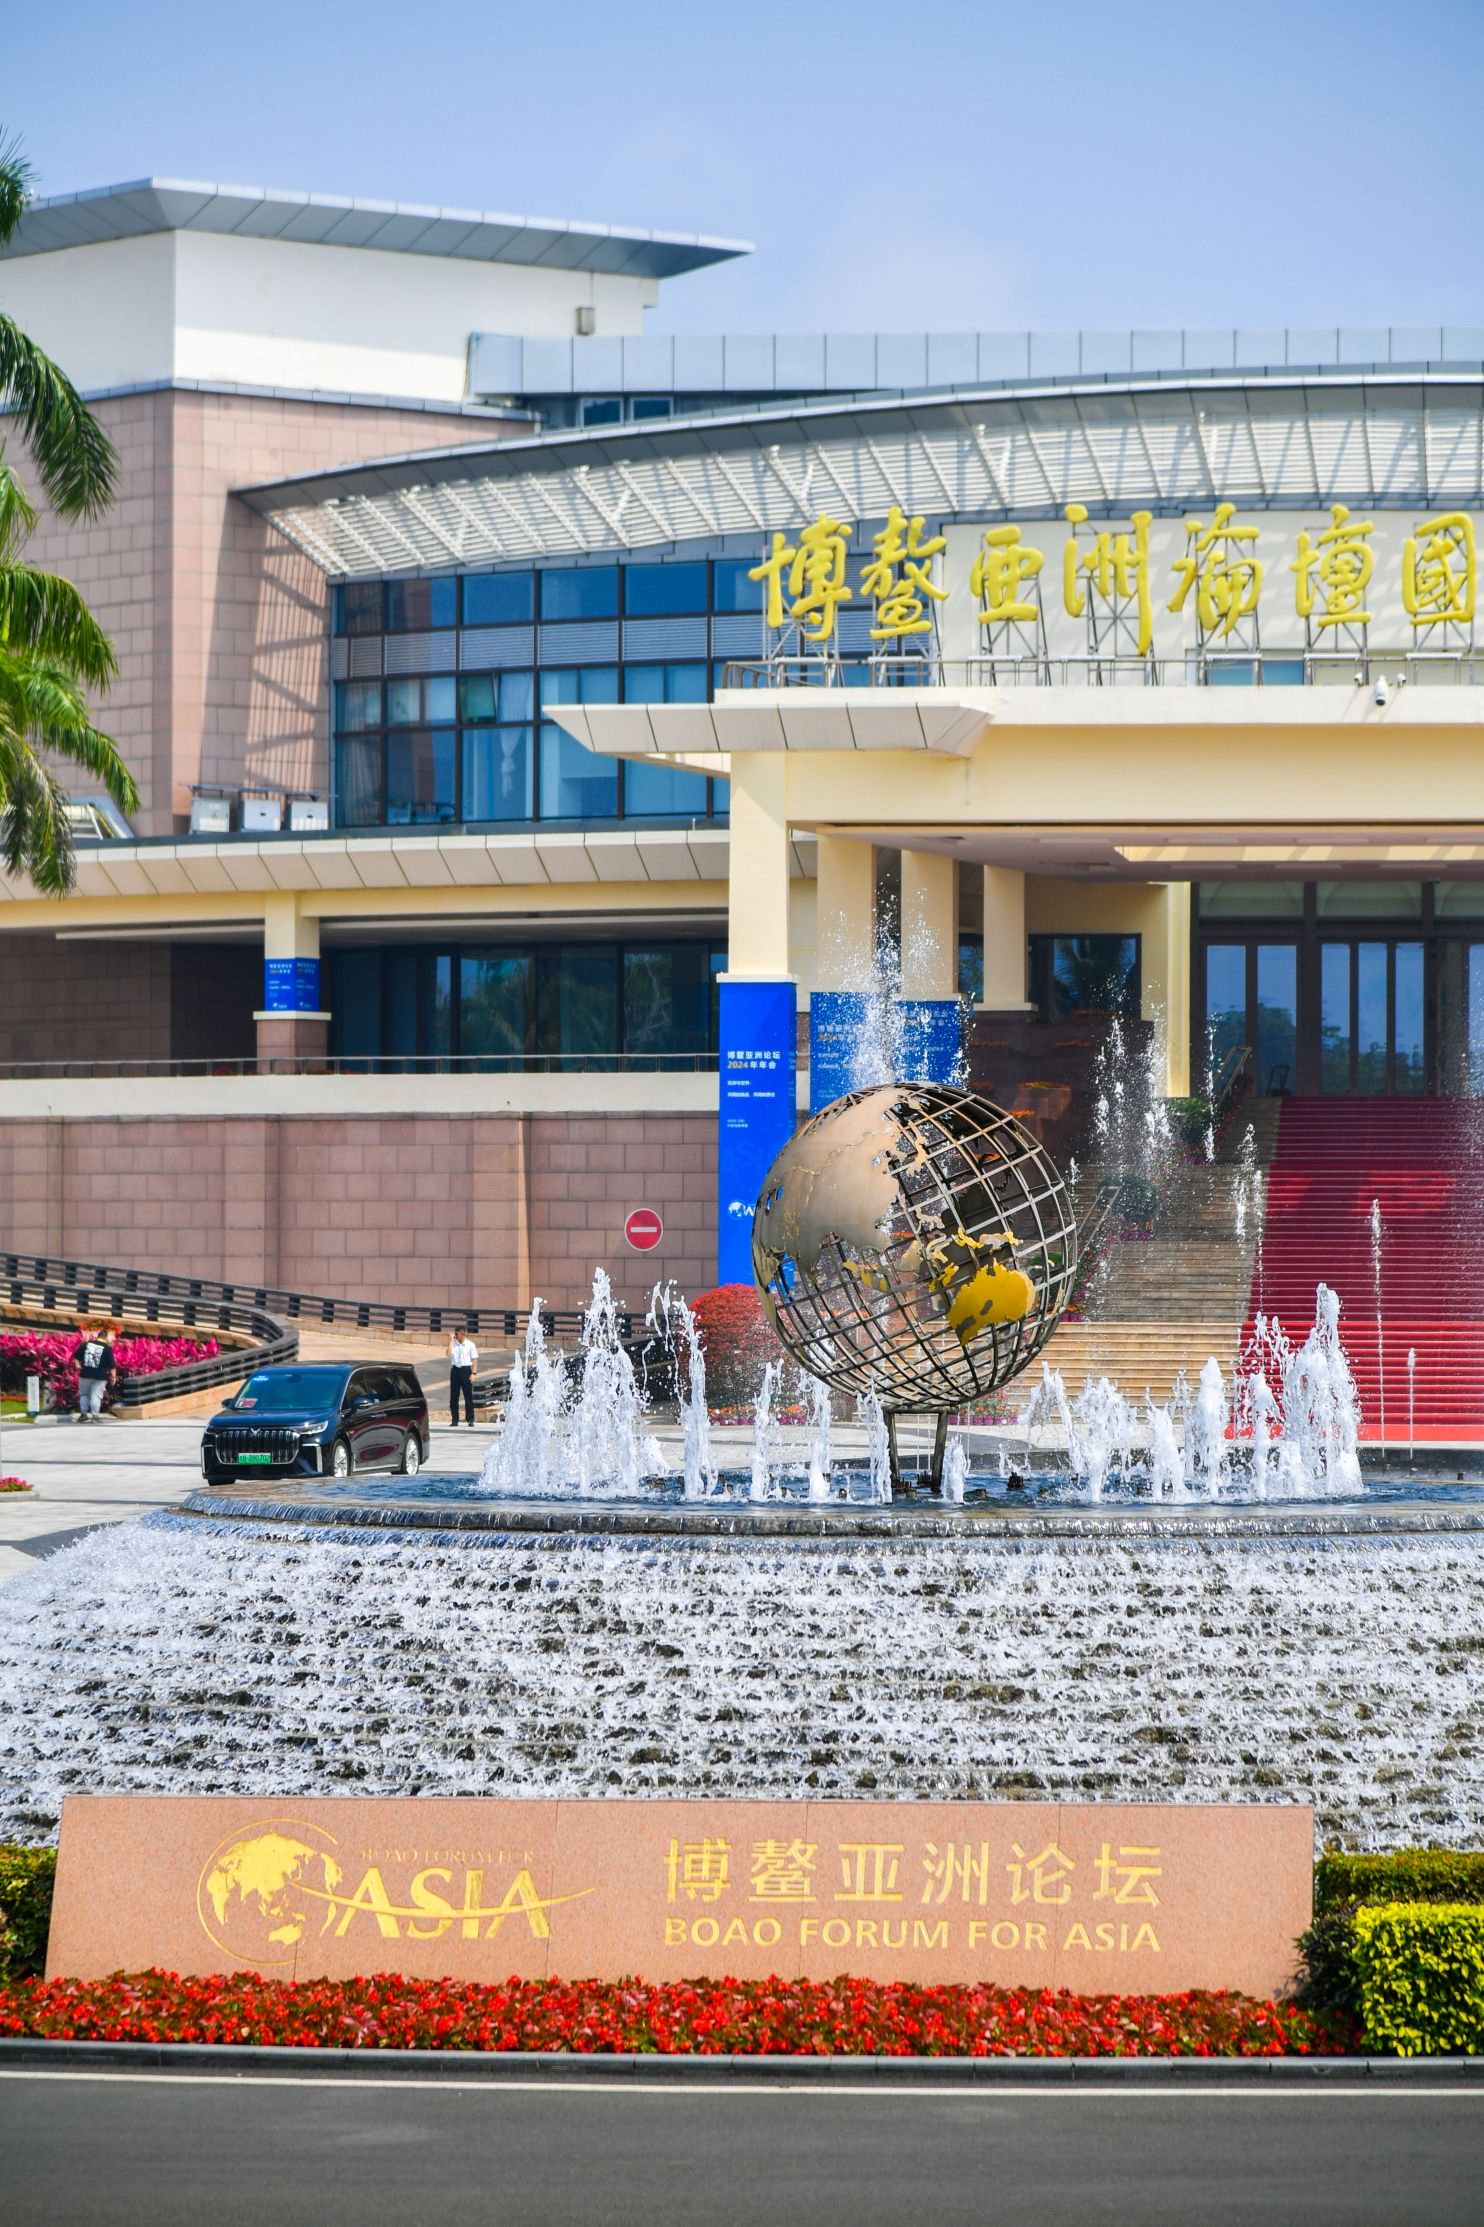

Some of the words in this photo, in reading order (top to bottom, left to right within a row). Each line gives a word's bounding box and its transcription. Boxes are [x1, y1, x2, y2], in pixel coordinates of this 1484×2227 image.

[362, 1848, 418, 1862] BOAO
[424, 1848, 492, 1863] FORUM
[497, 1849, 534, 1864] FOR
[664, 1837, 1163, 1907] 博鳌亚洲论坛
[334, 1866, 551, 1940] ASIA
[665, 1916, 783, 1947] BOAO
[800, 1918, 949, 1949] FORUM
[969, 1920, 1047, 1950] FOR
[1063, 1922, 1161, 1952] ASIA
